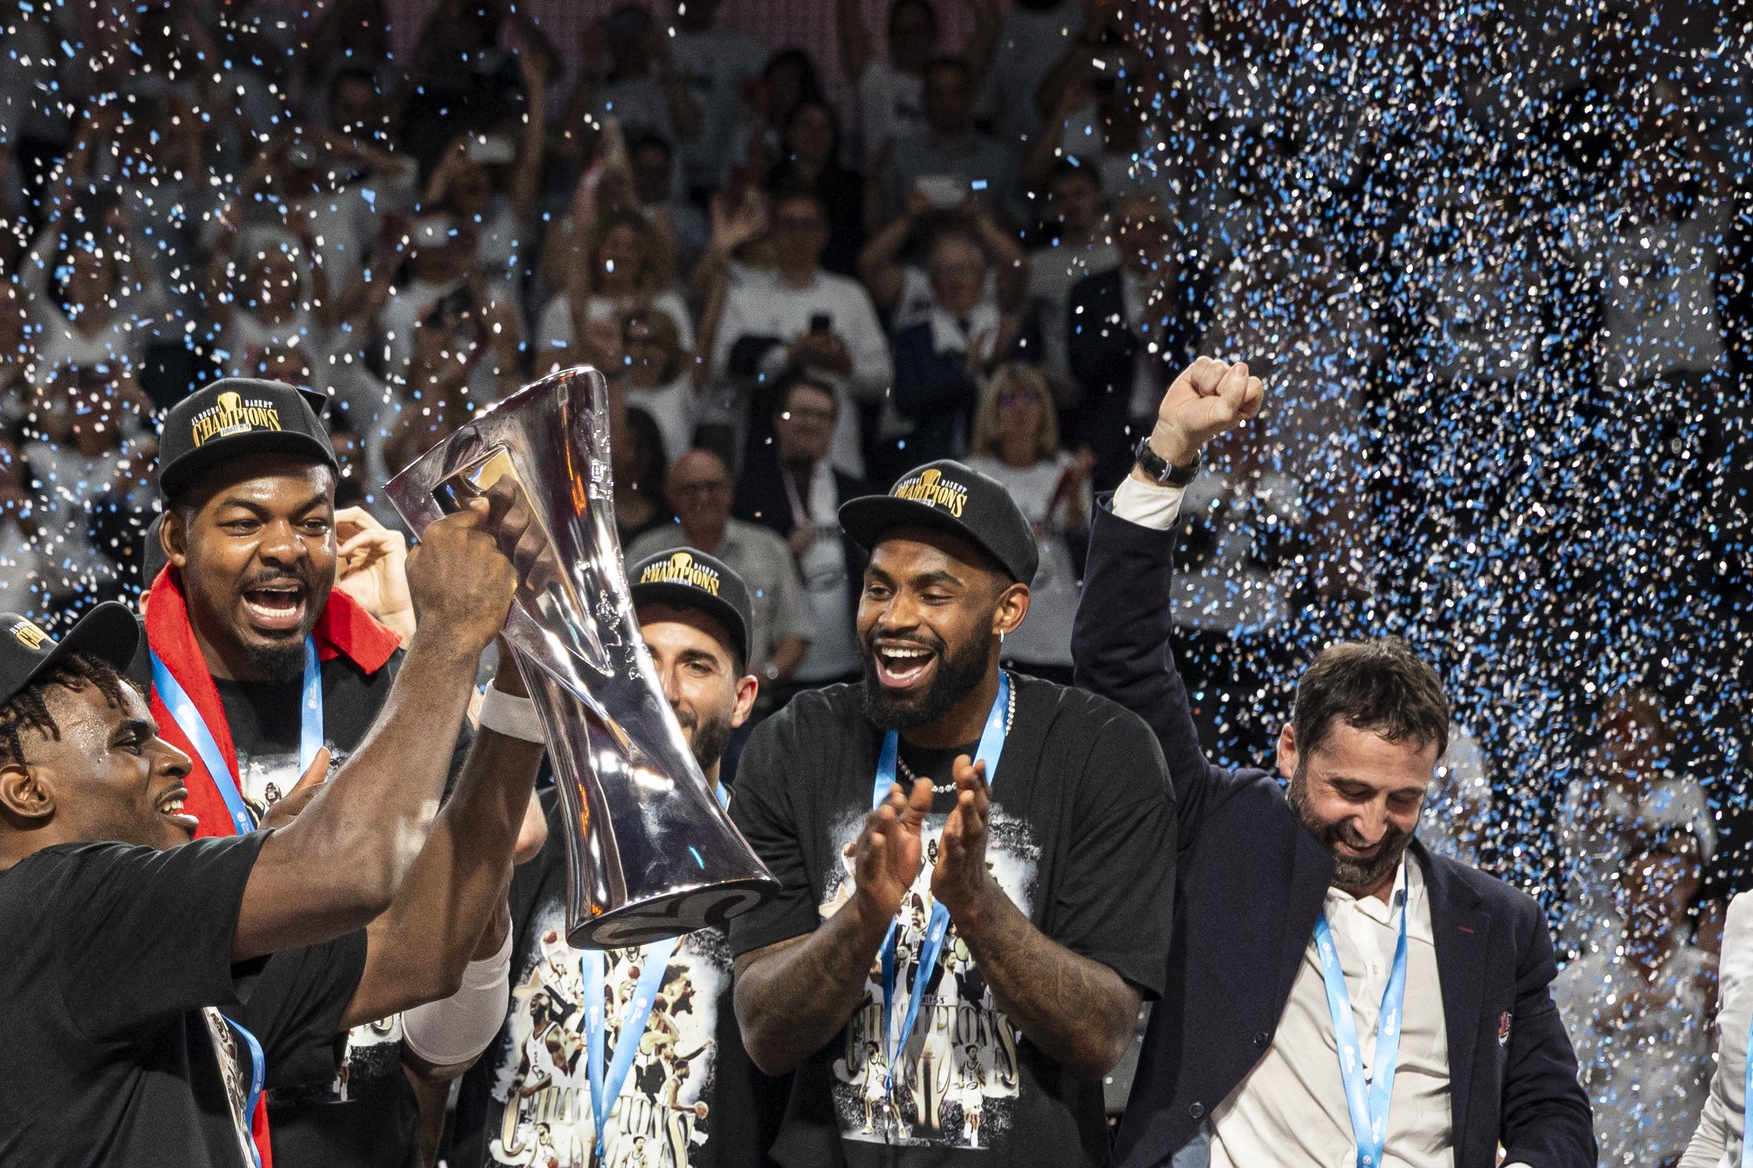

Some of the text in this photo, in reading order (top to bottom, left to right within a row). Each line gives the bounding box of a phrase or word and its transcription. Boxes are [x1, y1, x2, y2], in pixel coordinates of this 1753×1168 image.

[244, 399, 274, 409] BASKET
[192, 407, 282, 449] CHAMPIONS
[941, 479, 968, 494] BASKET
